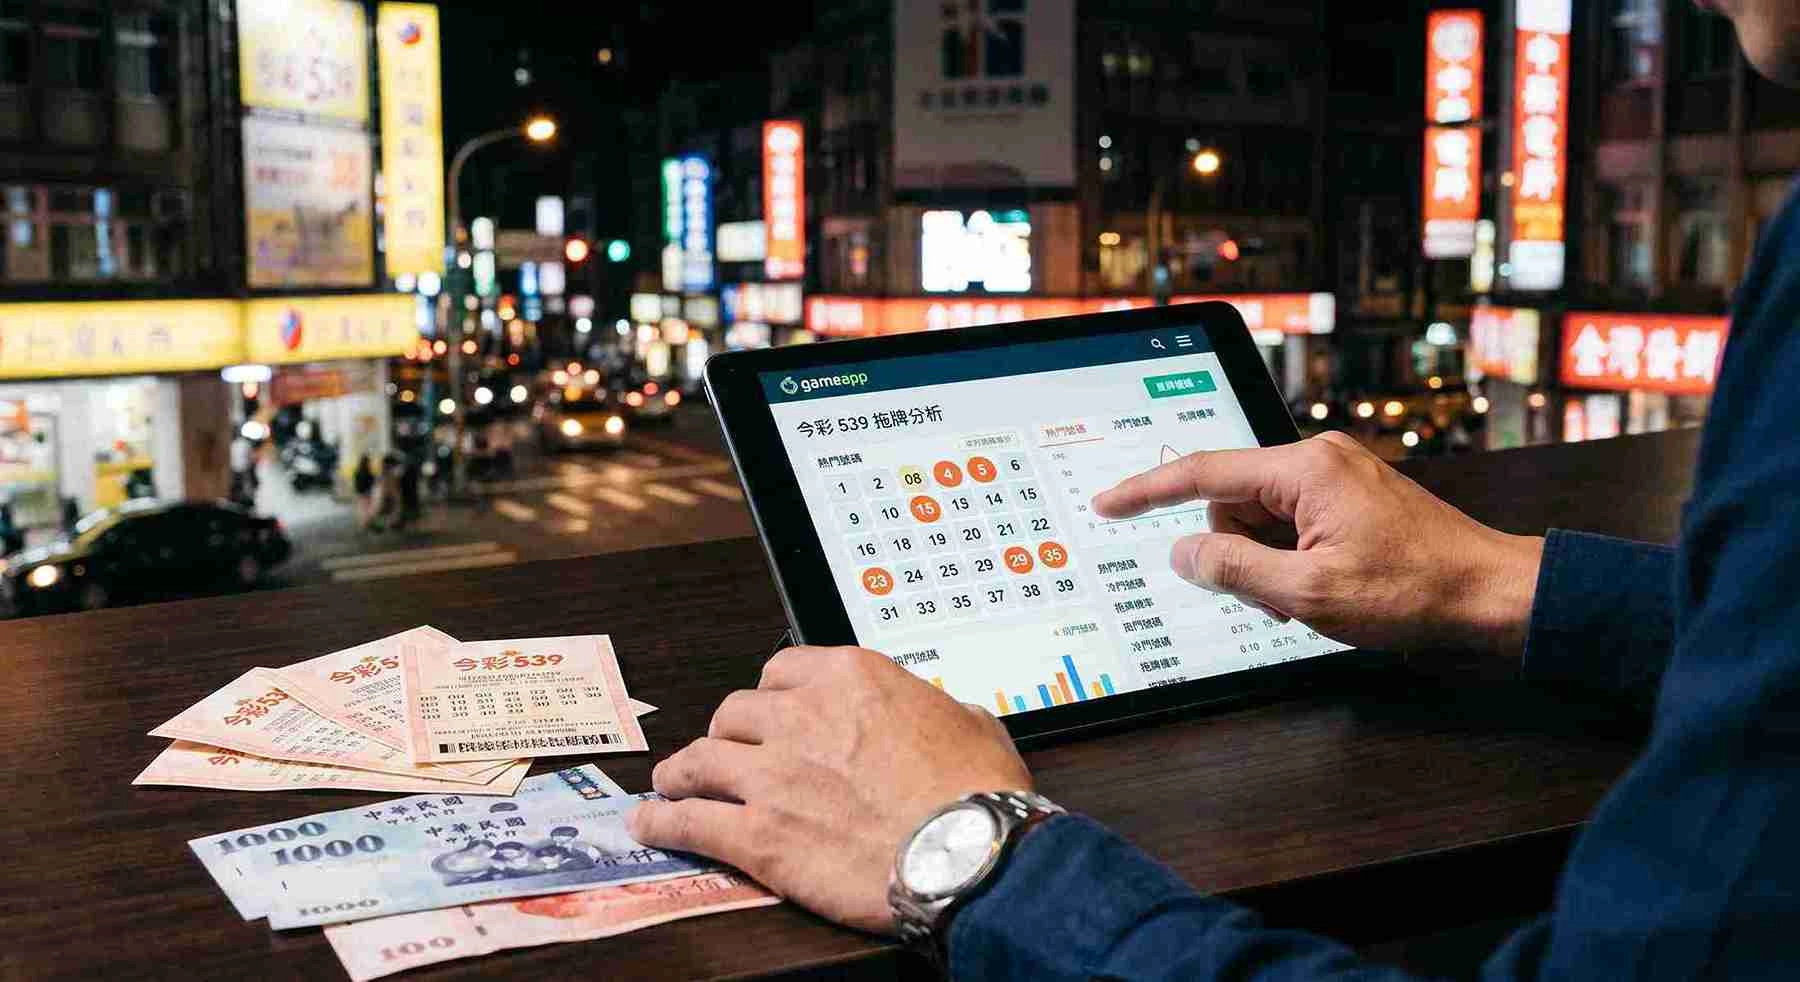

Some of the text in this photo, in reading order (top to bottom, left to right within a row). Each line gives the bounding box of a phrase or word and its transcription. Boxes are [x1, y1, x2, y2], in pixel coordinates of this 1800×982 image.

[801, 372, 868, 392] gameapp
[797, 404, 943, 438] 今彩 539 拖牌分析
[838, 459, 1021, 494] 1 2 08 4 5 6
[849, 512, 860, 525] 9
[882, 506, 900, 520] 10
[916, 502, 936, 517] 15
[985, 492, 1003, 506] 14
[1019, 487, 1037, 501] 15
[857, 517, 1050, 556] 16 18 19 20 21 22
[904, 569, 924, 583] 24
[939, 563, 959, 578] 25
[975, 558, 994, 572] 29
[1009, 553, 1028, 567] 29
[1042, 548, 1062, 562] 35
[880, 578, 1075, 621] 31 33 35 37 38 39
[329, 655, 400, 685] 今彩5
[452, 654, 563, 672] 今彩539
[363, 796, 464, 821] 中華民國
[214, 821, 327, 855] 1000
[424, 817, 527, 838] 中華民國
[272, 834, 386, 866] 1000
[380, 936, 457, 961] 100
